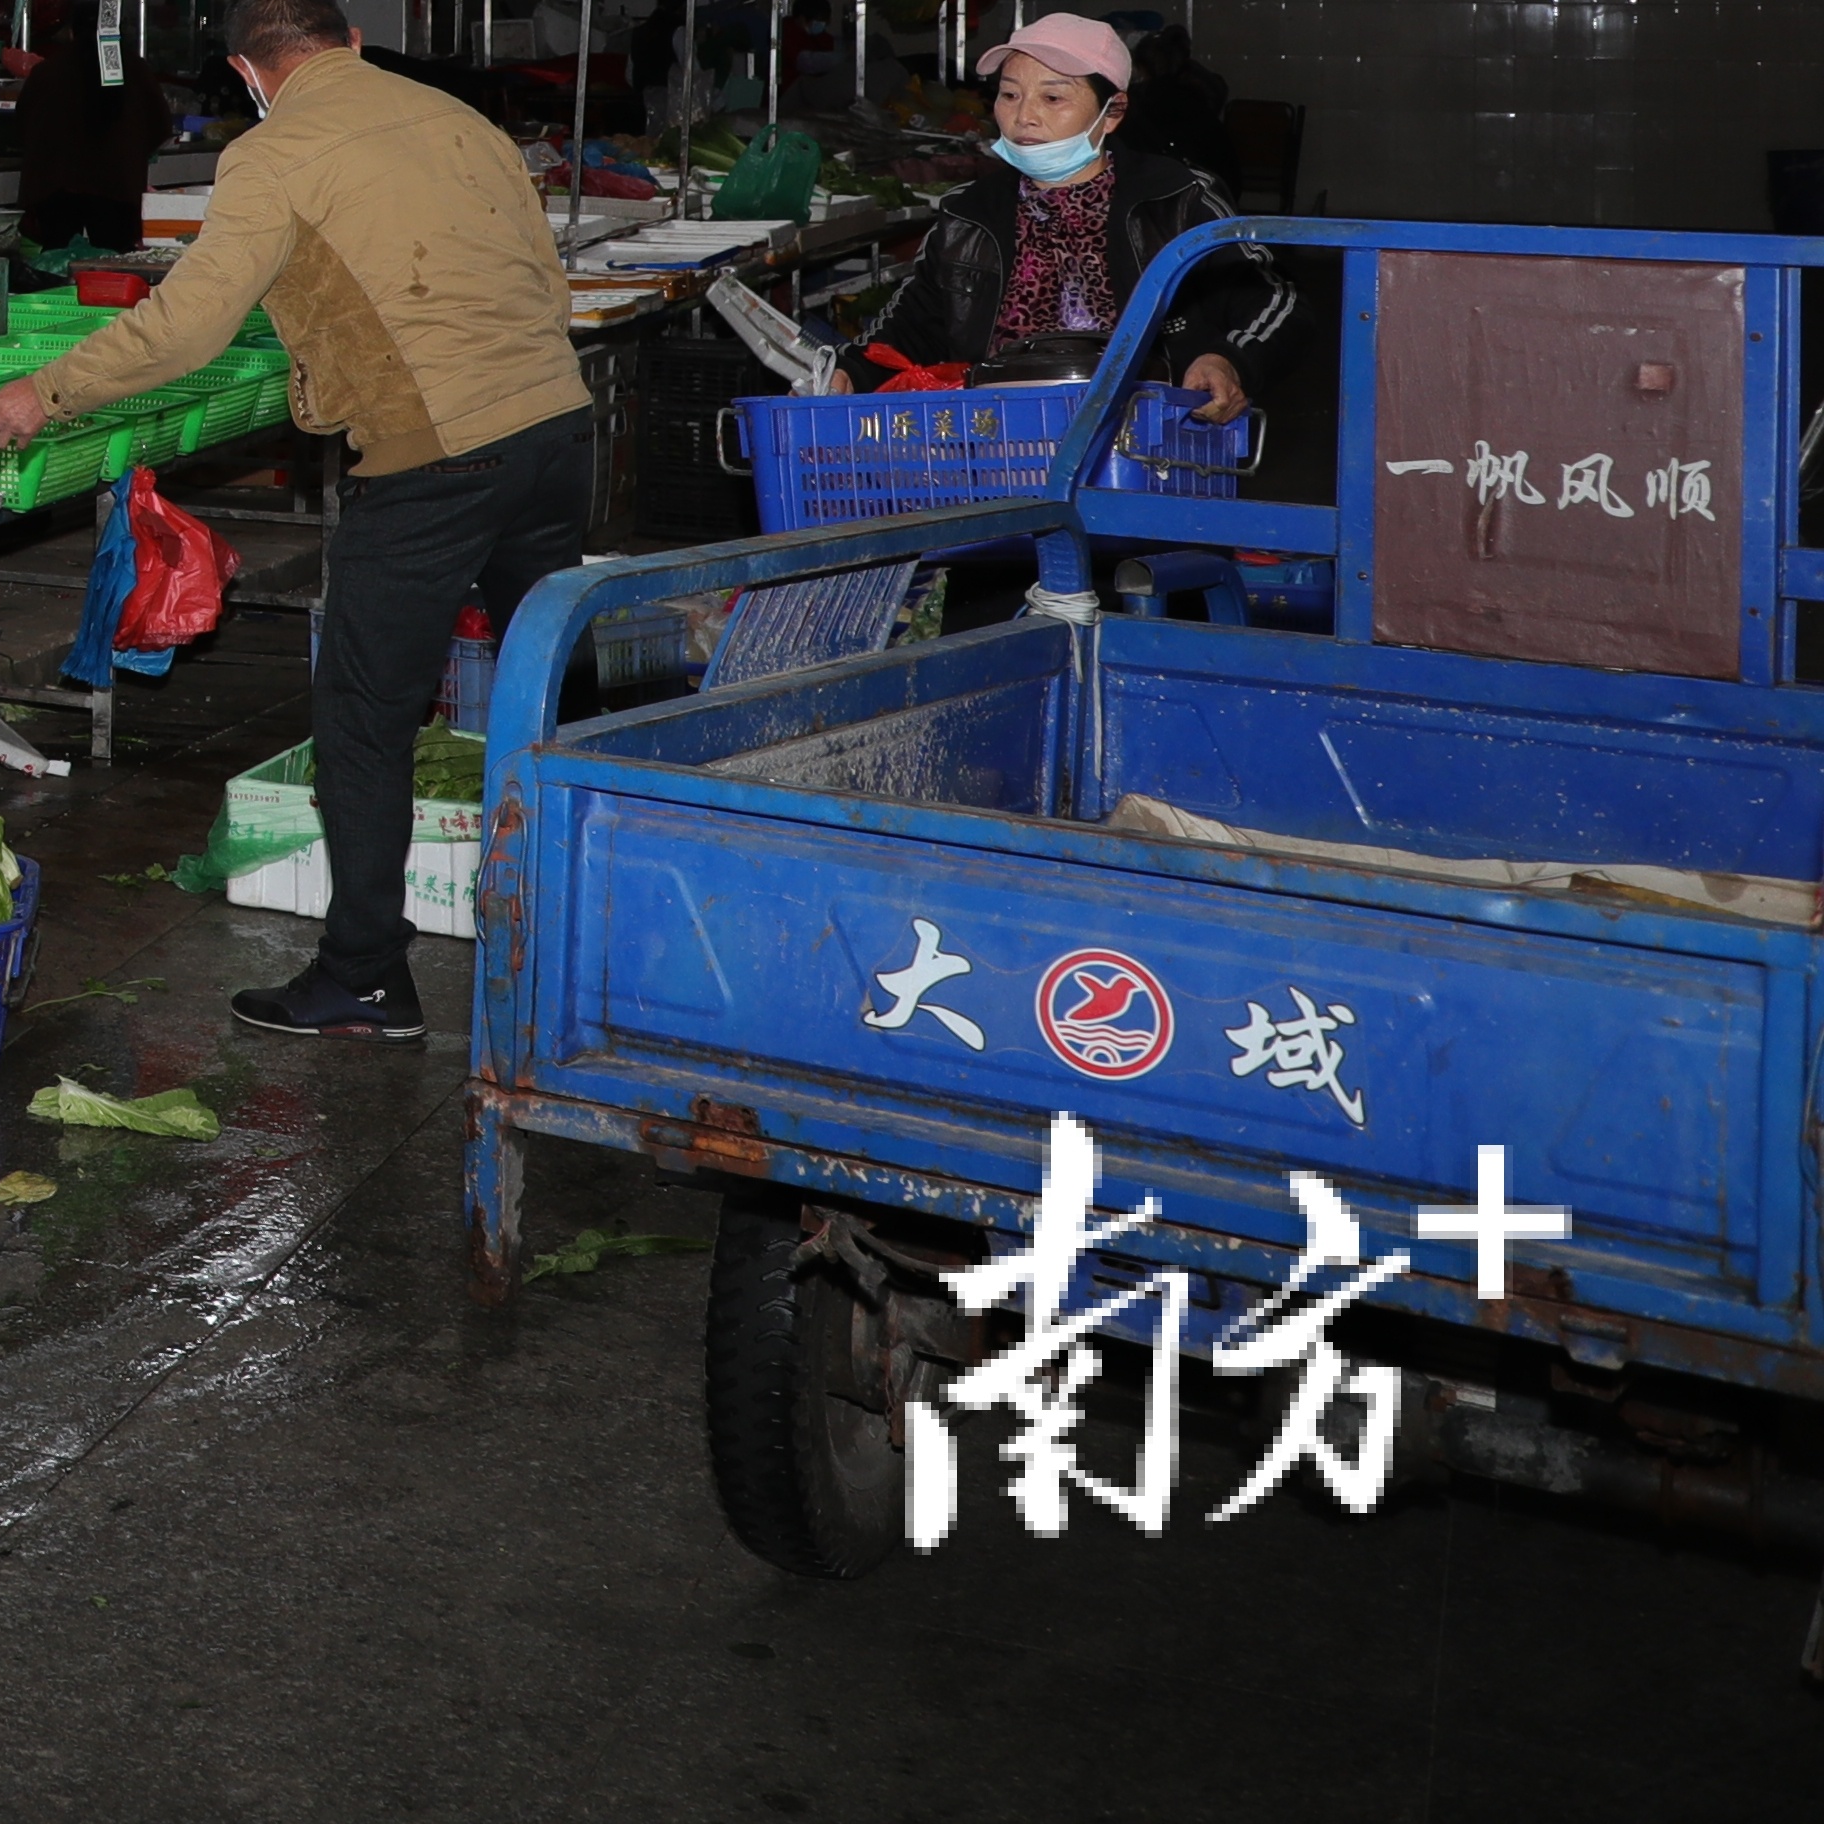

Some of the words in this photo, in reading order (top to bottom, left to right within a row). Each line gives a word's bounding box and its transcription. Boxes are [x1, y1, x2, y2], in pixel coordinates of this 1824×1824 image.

[857, 408, 1000, 443] 川乐菜场
[1387, 438, 1715, 523] 一帆风顺
[864, 919, 988, 1052] 大
[1226, 987, 1367, 1125] 域
